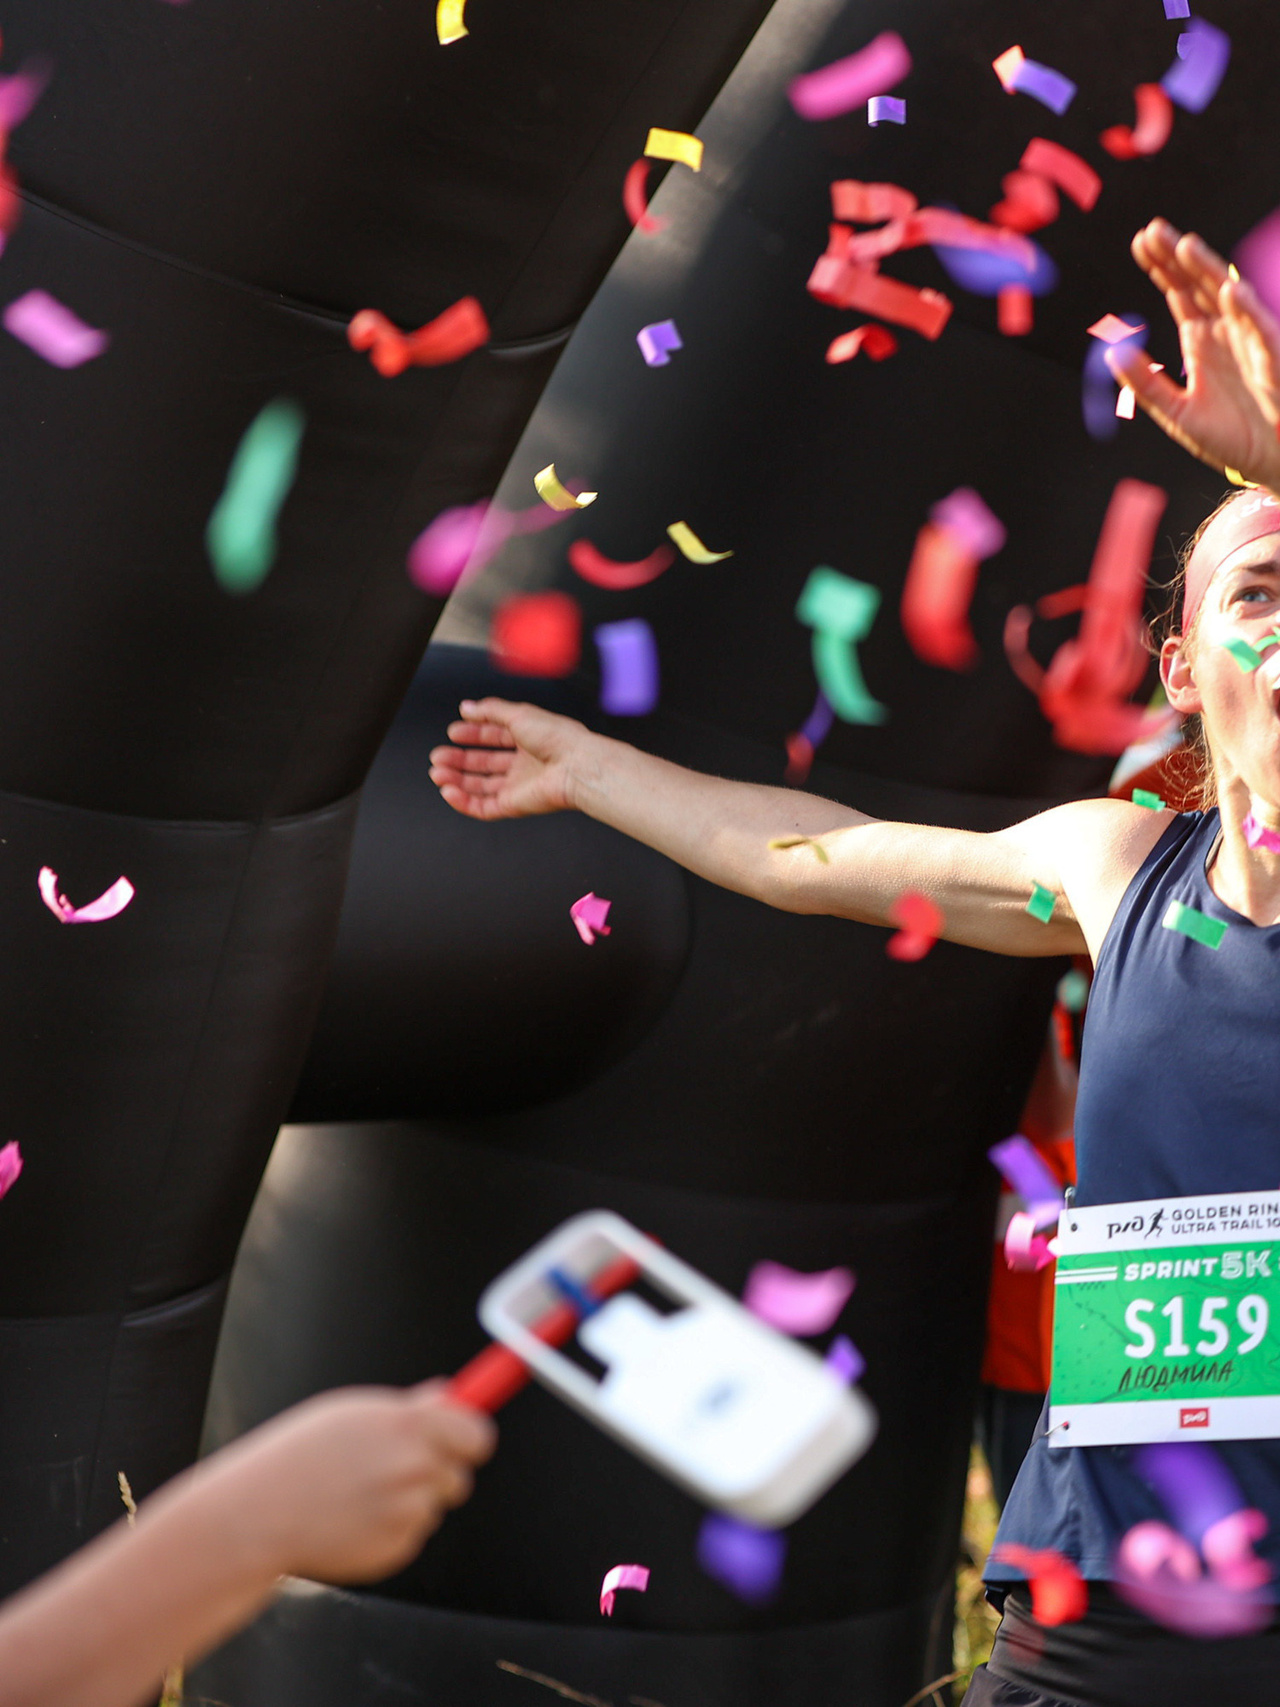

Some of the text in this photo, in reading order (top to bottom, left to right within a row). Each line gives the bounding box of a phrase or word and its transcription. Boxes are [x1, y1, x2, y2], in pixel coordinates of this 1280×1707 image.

[1171, 1204, 1241, 1221] GOLDEN
[1171, 1220, 1216, 1234] ULTRA
[1221, 1218, 1263, 1231] TRAIL
[1124, 1250, 1272, 1282] SPRINT 5K
[1124, 1294, 1269, 1359] S159
[1118, 1360, 1234, 1392] ЛЮДМИЛА
